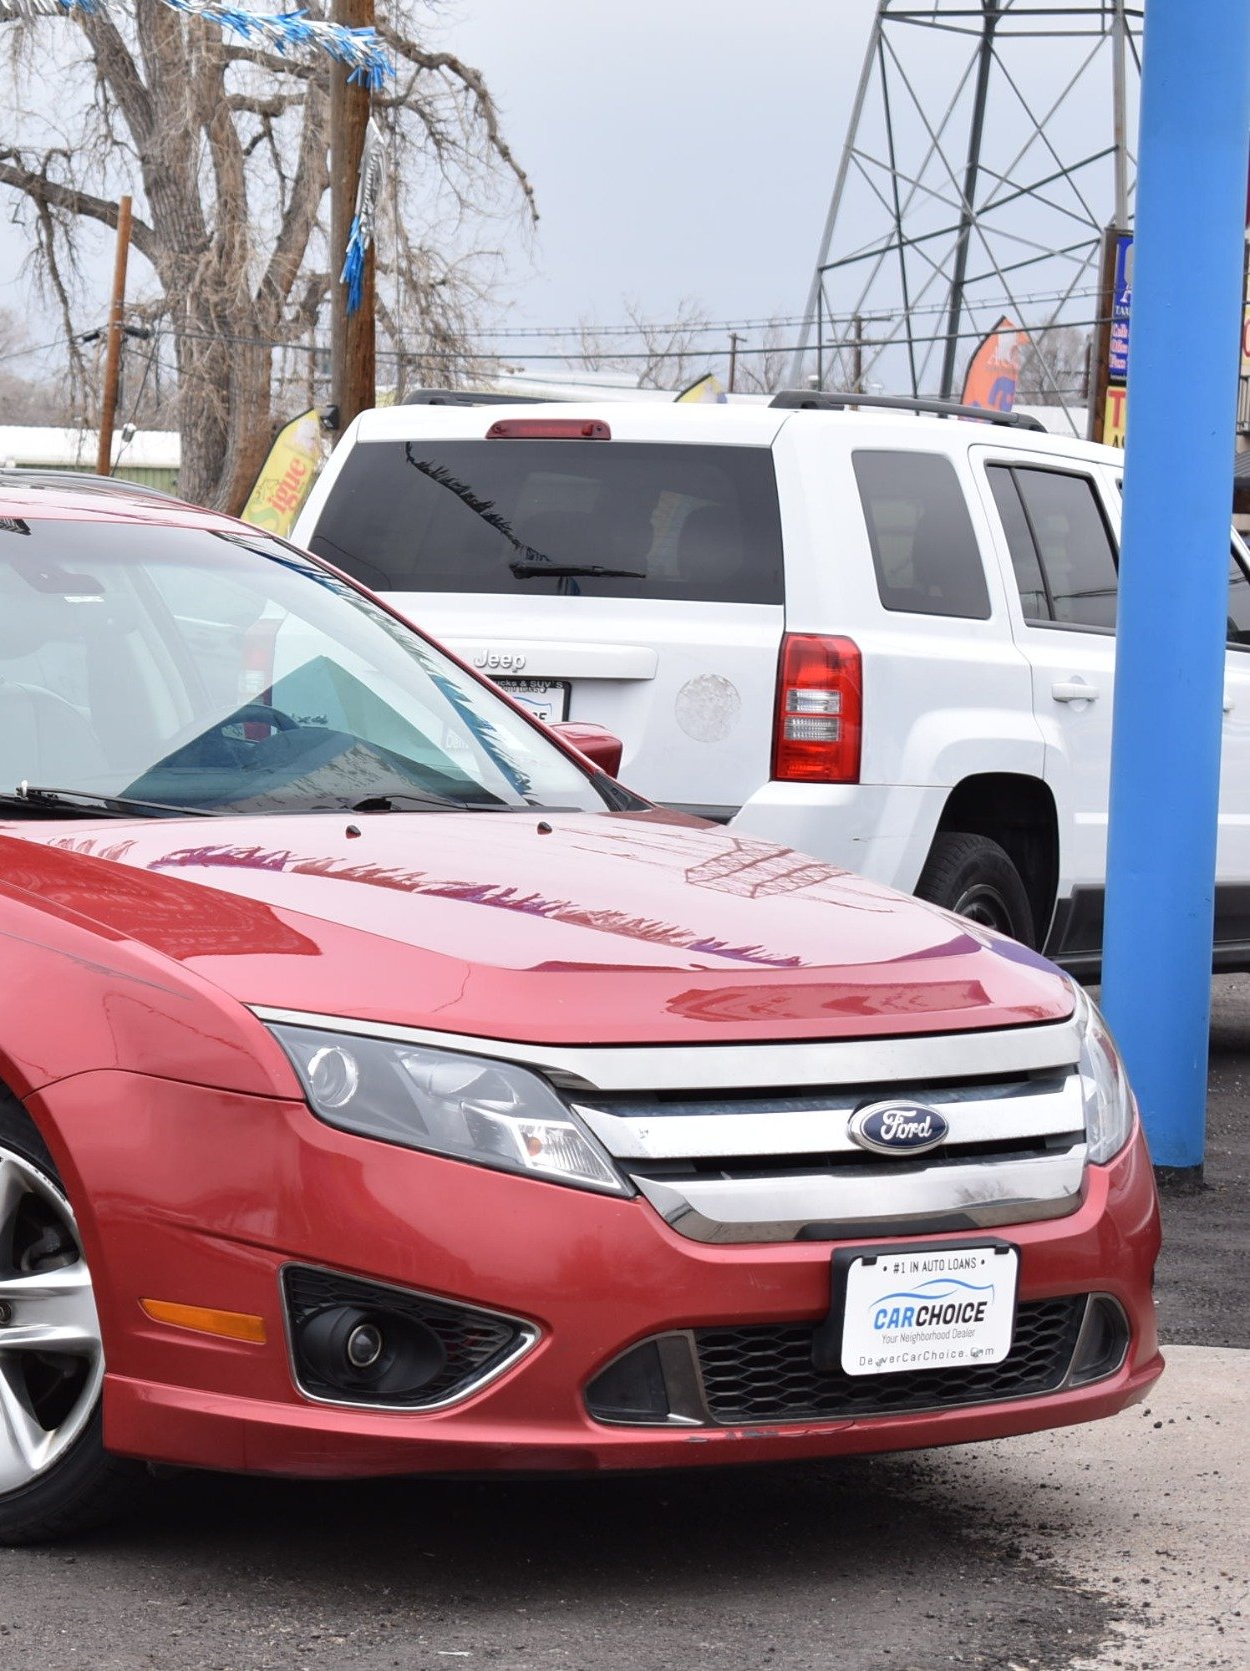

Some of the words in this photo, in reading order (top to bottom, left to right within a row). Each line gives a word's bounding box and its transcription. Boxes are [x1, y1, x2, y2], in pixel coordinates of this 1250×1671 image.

[474, 649, 526, 672] Jeep
[880, 1110, 932, 1140] Ford
[893, 1263, 906, 1274] #1
[910, 1261, 919, 1273] IN
[922, 1259, 945, 1272] AUTO
[948, 1257, 977, 1270] LOANS
[882, 1333, 898, 1344] Your
[900, 1330, 950, 1345] Neighborhood
[952, 1328, 976, 1339] Dealer
[859, 1347, 994, 1367] DeverCarChoice.Cm
